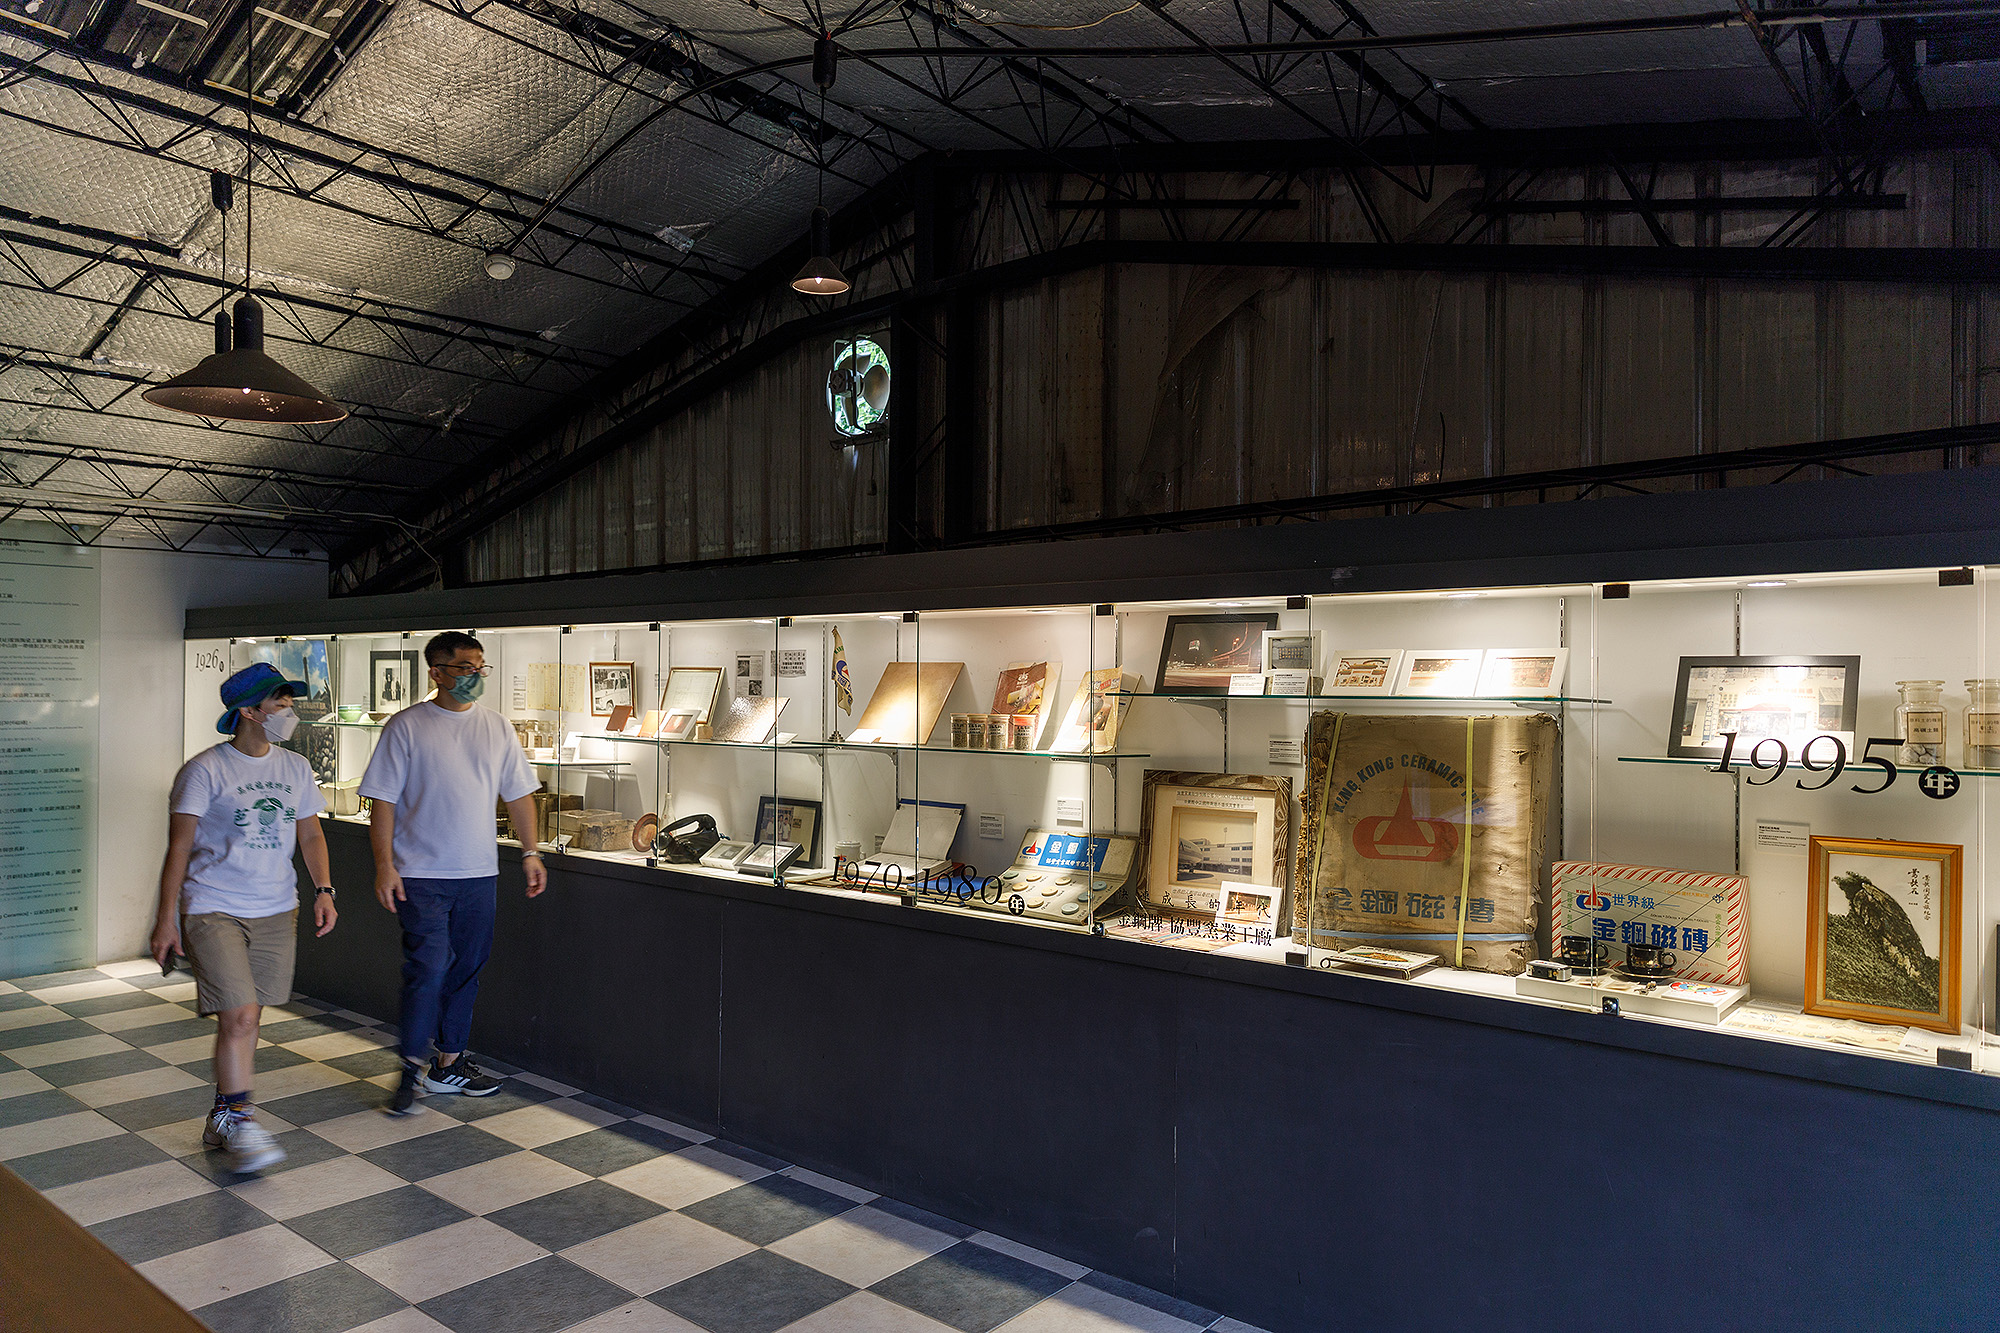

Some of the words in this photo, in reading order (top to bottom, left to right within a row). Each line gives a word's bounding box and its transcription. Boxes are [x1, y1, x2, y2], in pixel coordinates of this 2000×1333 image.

[1333, 779, 1358, 814] KING
[1356, 756, 1395, 784] KONG
[1400, 753, 1464, 789] CERAMIC
[1117, 888, 1271, 919] 快速成長的年代
[1321, 886, 1496, 924] 金鋼磁磚
[1611, 893, 1655, 910] 世界級
[1592, 917, 1710, 953] 金鋼磁磚
